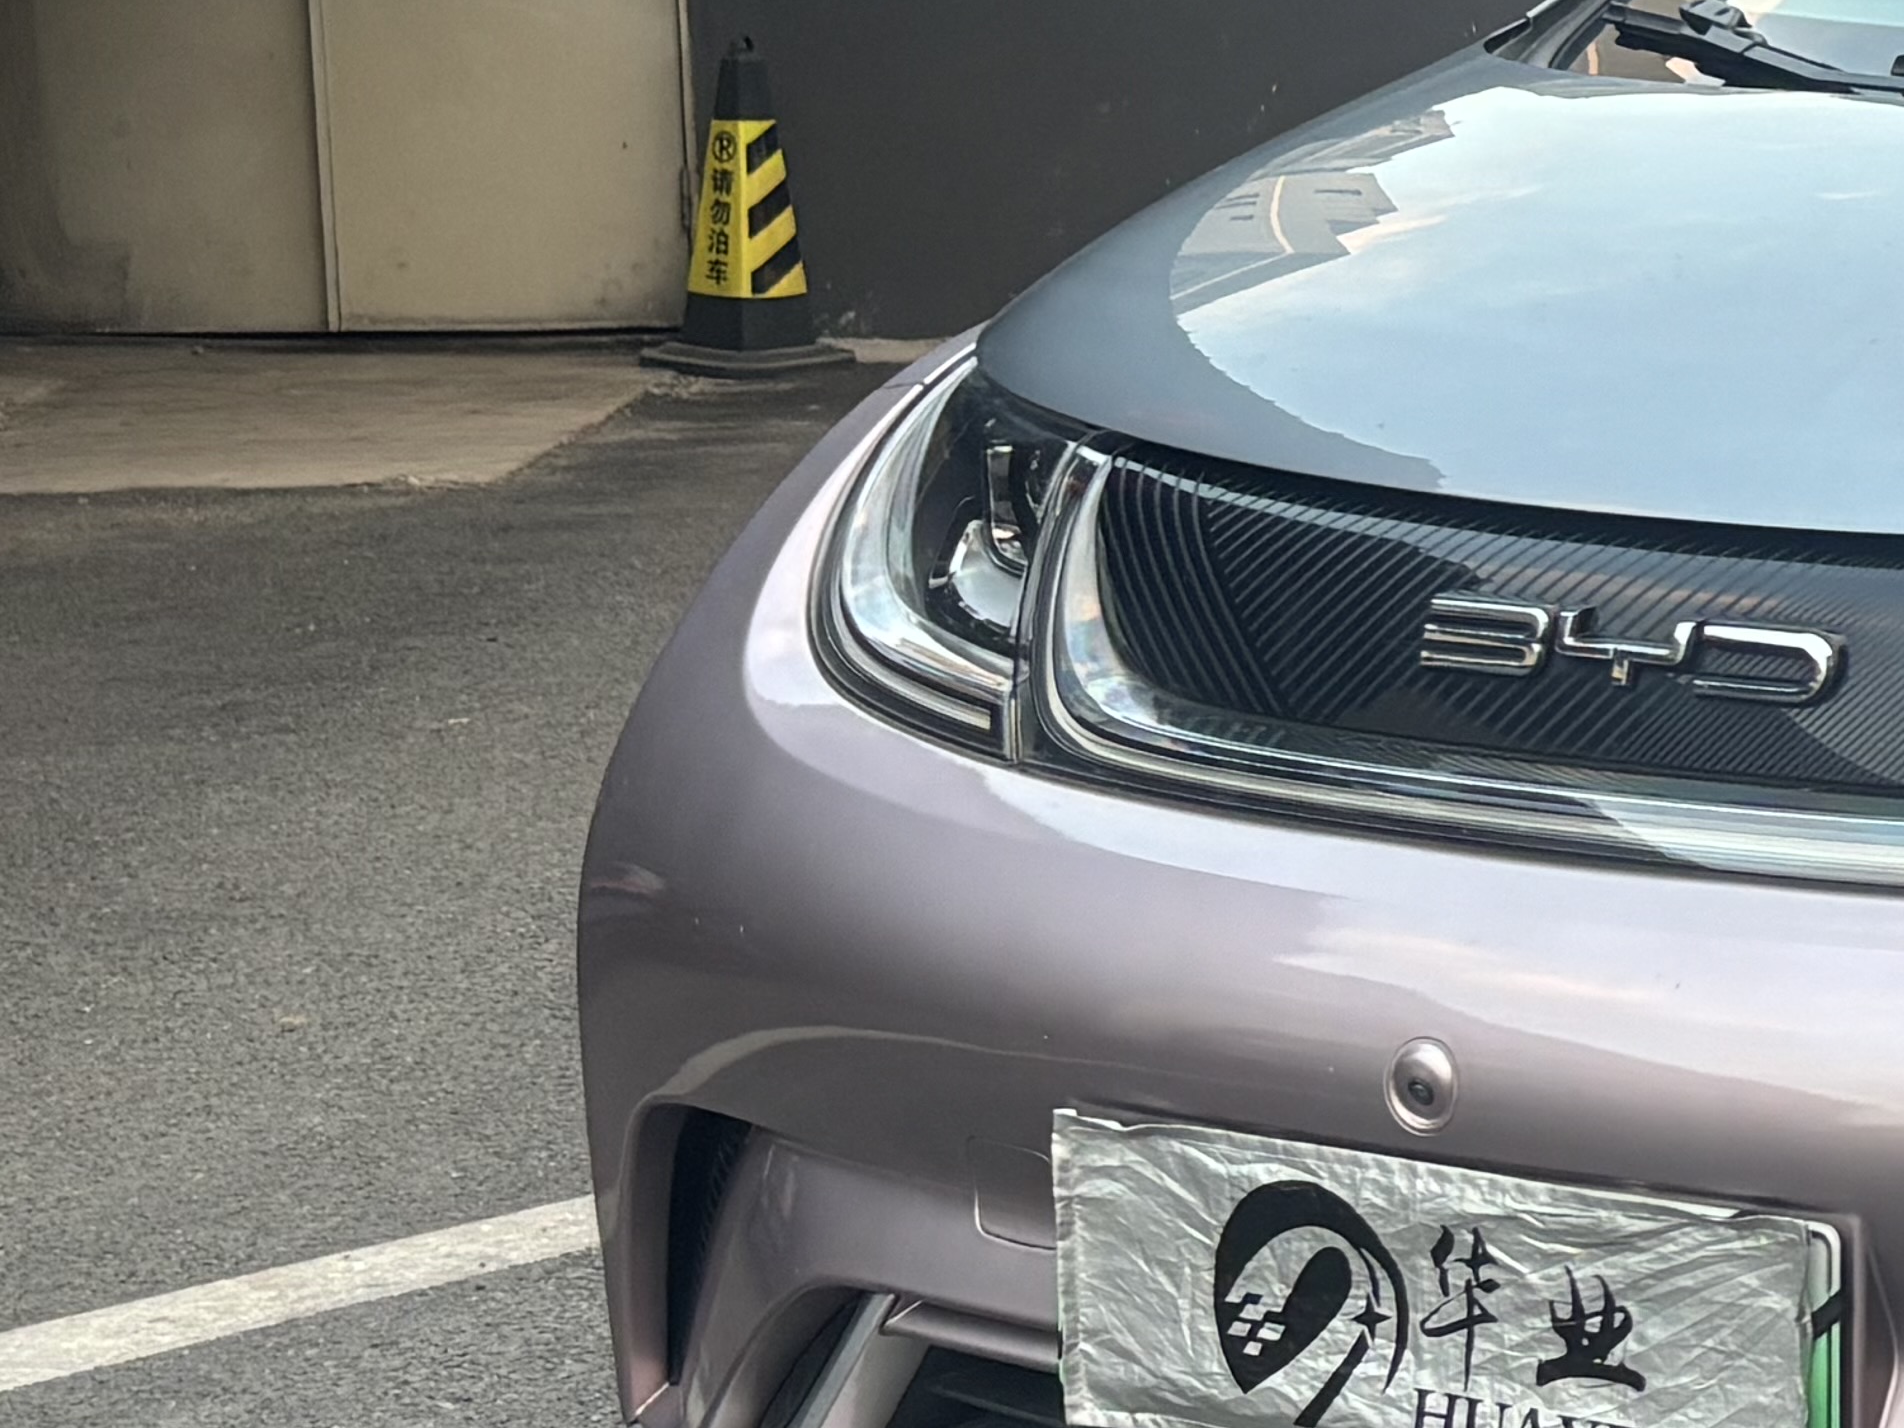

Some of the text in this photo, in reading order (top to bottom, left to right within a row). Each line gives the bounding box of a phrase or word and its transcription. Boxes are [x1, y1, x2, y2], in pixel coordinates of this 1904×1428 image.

[706, 167, 735, 286] 请勿泊车
[1419, 589, 1848, 707] BYD
[1419, 1224, 1646, 1393] 华业
